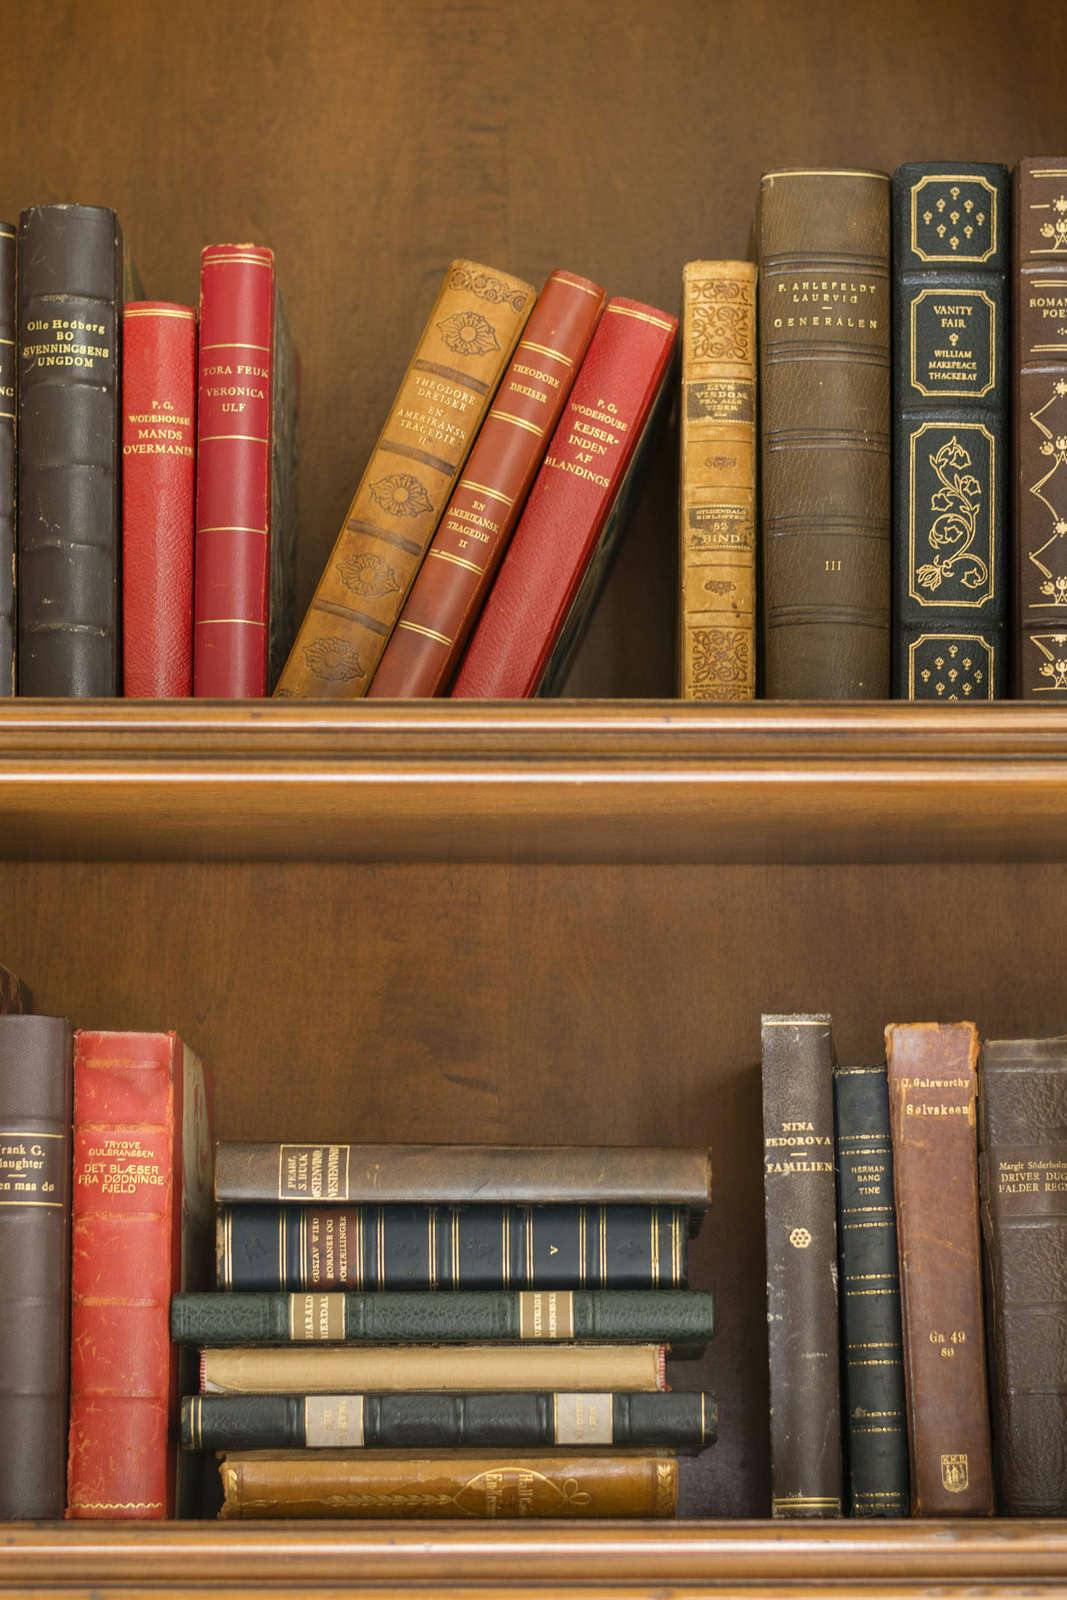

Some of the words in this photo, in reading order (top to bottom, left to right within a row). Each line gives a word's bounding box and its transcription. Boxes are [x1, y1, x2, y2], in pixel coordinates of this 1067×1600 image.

[792, 282, 876, 294] AHLEFELDT
[1029, 298, 1067, 308] ROMA
[934, 306, 972, 316] VANITY
[28, 321, 49, 331] Olle
[52, 320, 105, 335] Hedberg
[941, 318, 966, 328] FAIR
[56, 332, 74, 341] BO
[23, 344, 109, 358] SVENNINGSENS
[934, 350, 972, 358] WILLIAM
[37, 356, 94, 368] UNGDOM
[928, 361, 976, 370] MAKEPEACE
[203, 365, 232, 377] TORA
[236, 365, 268, 378] FEUK
[513, 364, 560, 388] THEODORE
[928, 372, 977, 380] THACKERAY
[207, 386, 264, 400] VERONICA
[416, 377, 476, 405] THEODORE
[510, 382, 547, 403] DREISER
[152, 401, 160, 410] P.
[163, 401, 174, 410] G.
[418, 388, 466, 412] DREISER
[222, 403, 246, 412] ULF
[428, 406, 443, 417] EN
[597, 400, 606, 408] P.
[607, 403, 618, 414] G.
[129, 415, 191, 425] WODEHOUSE
[572, 403, 628, 432] WODEHOUSE
[138, 430, 182, 440] MANDS
[400, 419, 456, 446] TRAGEDIE
[568, 434, 608, 455] INDEN
[576, 452, 593, 464] AF
[544, 456, 610, 488] BLANDINGS
[472, 500, 486, 512] EN
[447, 521, 490, 544] TRAGEDIE
[704, 534, 740, 543] BIND
[825, 560, 841, 571] III
[914, 1078, 970, 1088] Galsworthy
[782, 1122, 814, 1132] NINA
[104, 1140, 141, 1149] TRYGVE
[765, 1136, 832, 1147] FEDOROVA
[88, 1146, 154, 1158] GULBRANSSEN
[84, 1164, 107, 1174] DET
[110, 1164, 159, 1175] BLÆSER
[288, 1155, 298, 1190] PEARL
[766, 1161, 832, 1174] FAMILIEN
[998, 1162, 1024, 1172] Margit
[78, 1174, 99, 1184] FRA
[104, 1174, 164, 1186] DØDNINGE
[857, 1174, 880, 1182] BANG
[1001, 1172, 1040, 1182] DRIVER
[102, 1184, 136, 1194] FJELD
[858, 1186, 880, 1195] TINE
[998, 1183, 1040, 1193] FALDER
[312, 1218, 320, 1243] WIED
[326, 1219, 334, 1233] OG
[550, 1244, 558, 1256] V
[326, 1234, 334, 1279] ROMANER
[312, 1246, 320, 1282] GUSTAV
[304, 1295, 314, 1338] HARALD
[320, 1295, 328, 1339] HERDAL
